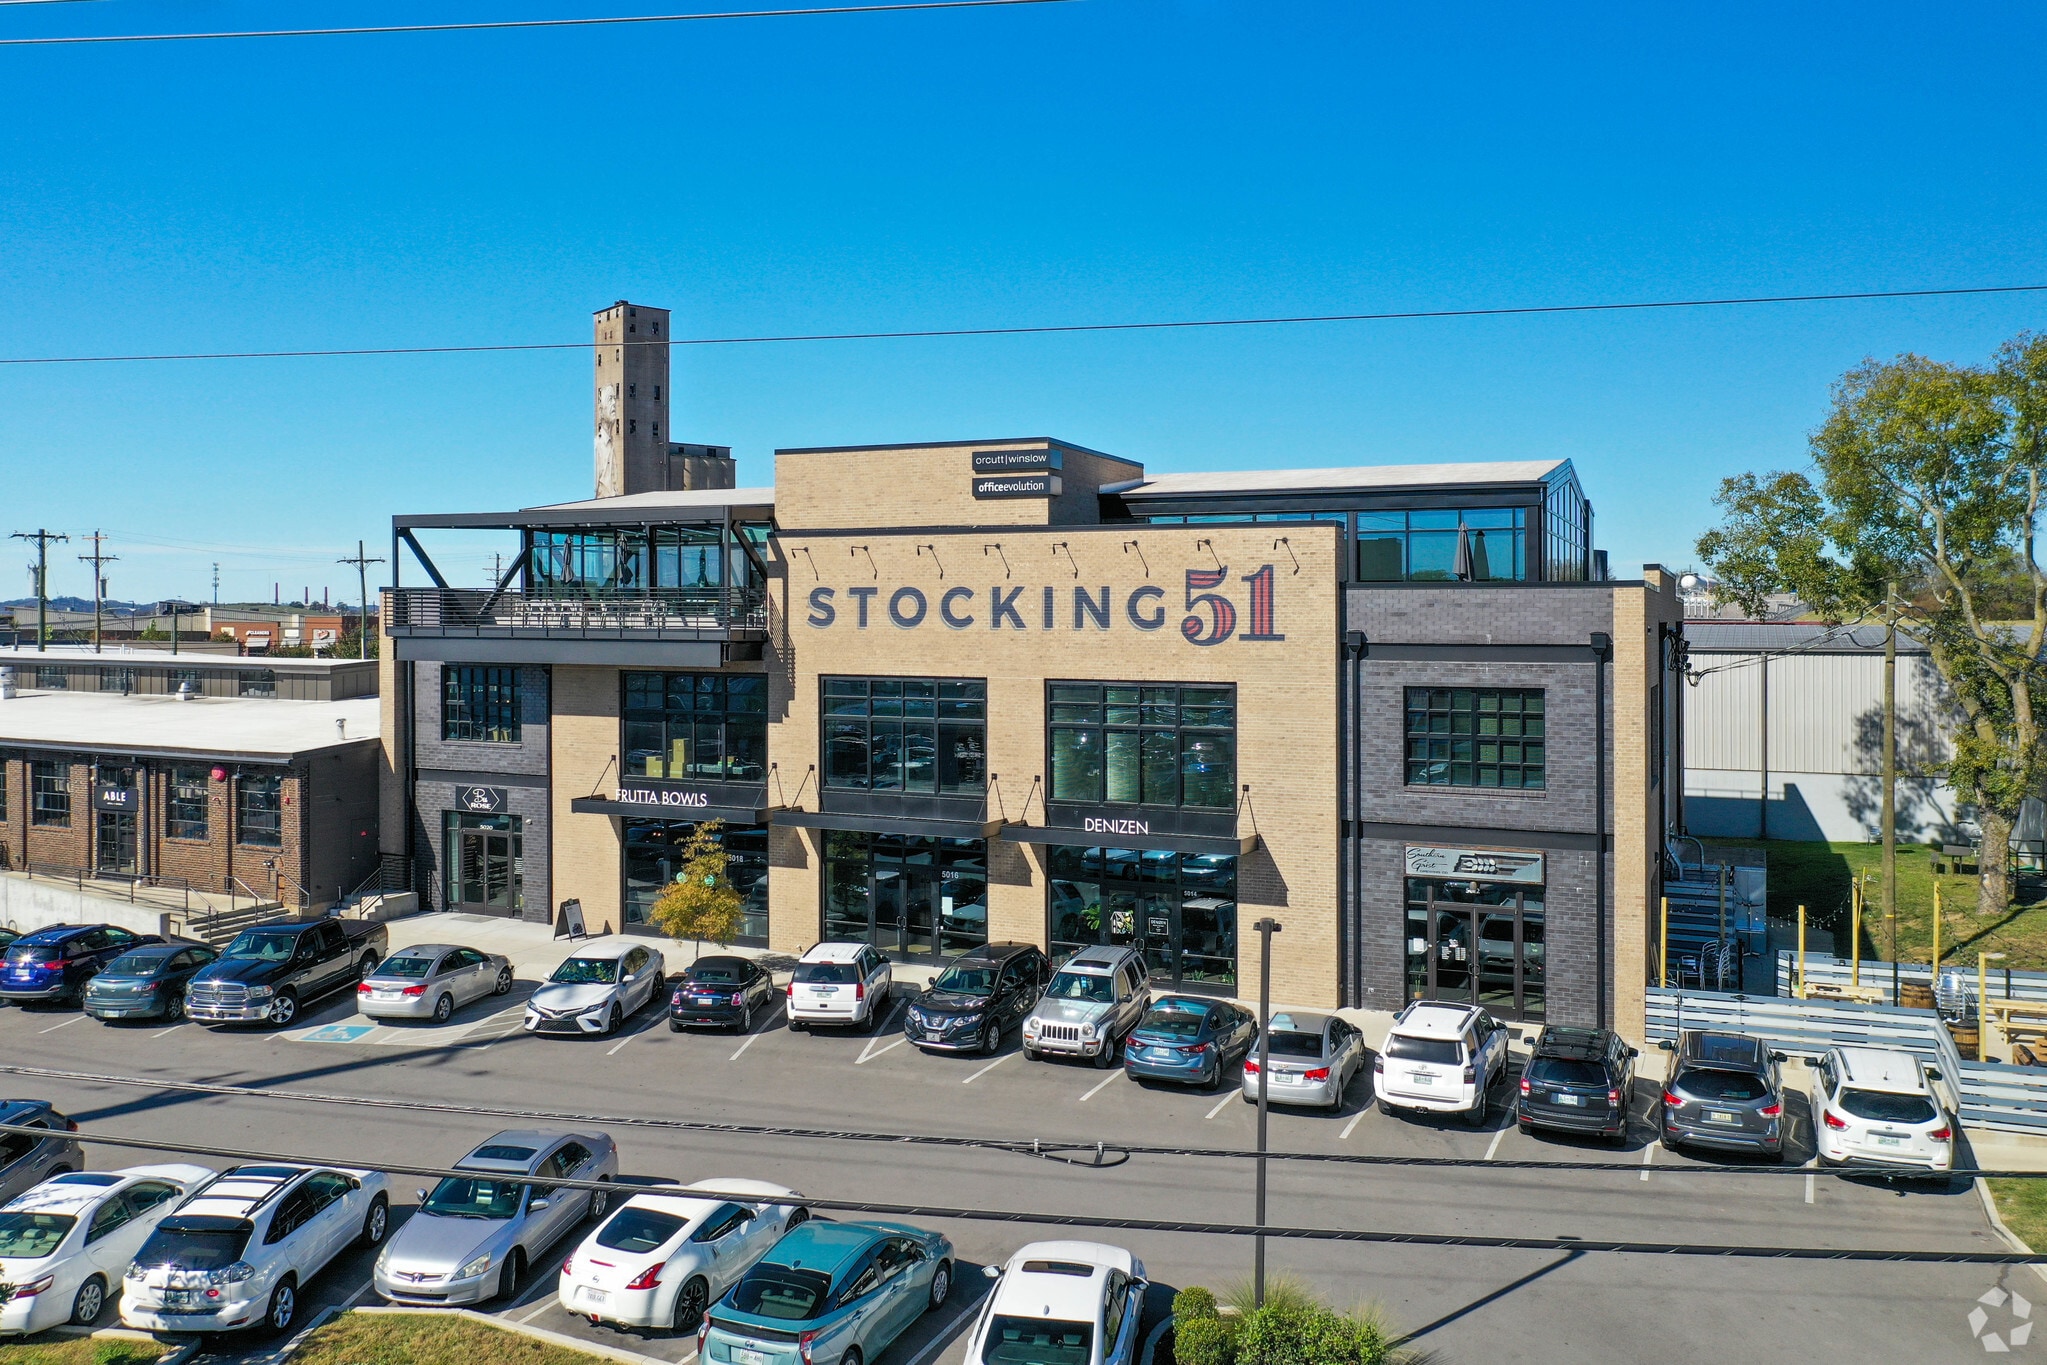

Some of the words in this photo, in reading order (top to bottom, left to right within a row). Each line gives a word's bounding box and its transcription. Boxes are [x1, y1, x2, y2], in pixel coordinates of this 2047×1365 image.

[978, 480, 1044, 492] officeevolution
[806, 585, 1166, 632] STOCKING
[1180, 564, 1286, 647] 51
[103, 790, 126, 802] ABLE
[615, 789, 658, 804] FRUTTA
[662, 791, 708, 807] BOWLS
[1085, 817, 1149, 835] DENIZEN
[1406, 848, 1446, 859] Southern
[941, 870, 960, 879] 5016
